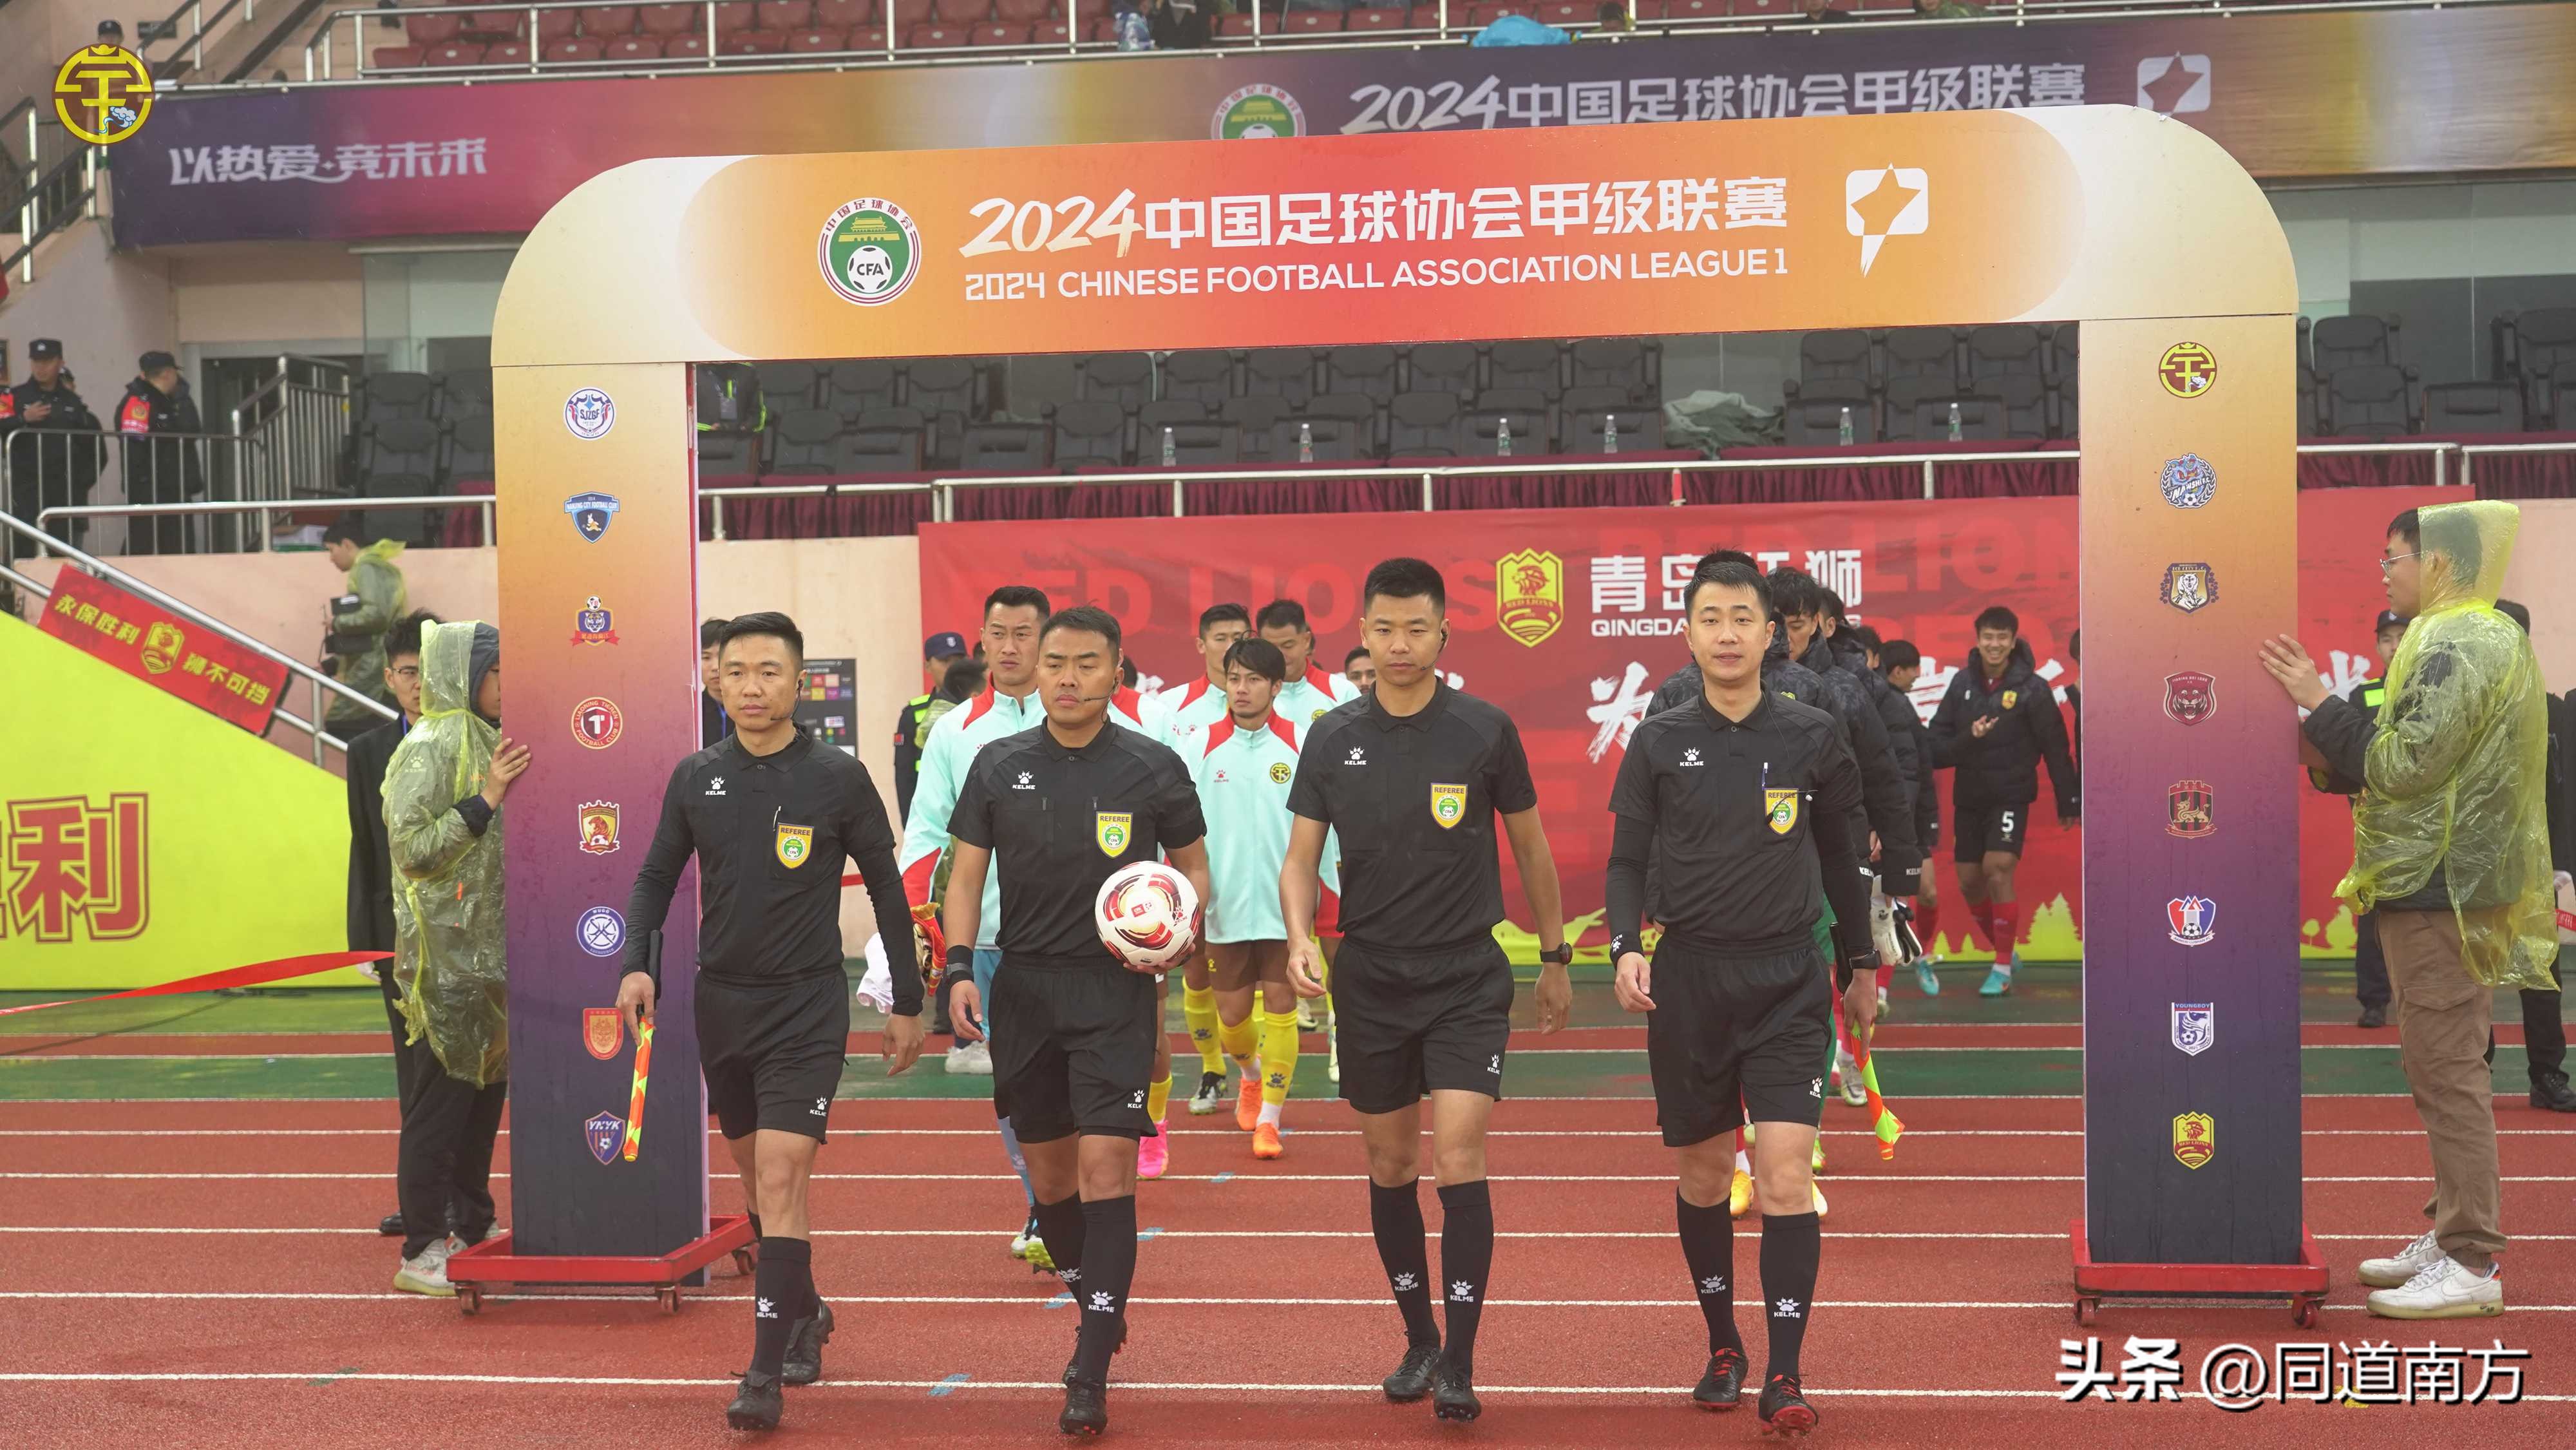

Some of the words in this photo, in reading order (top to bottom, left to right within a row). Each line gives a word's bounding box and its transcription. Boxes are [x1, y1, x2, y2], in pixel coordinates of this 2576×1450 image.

[826, 199, 913, 232] 中国足球协会
[857, 263, 884, 276] CFA
[965, 272, 1045, 301] 2024
[1058, 267, 1199, 298] CHINESE
[1207, 262, 1384, 293] FOOTBALL
[1391, 253, 1622, 287] ASSOCIATION
[1631, 248, 1768, 280] LEAGUE
[1775, 248, 1788, 274] 1
[55, 593, 141, 645] 永保胜利
[1591, 618, 1688, 637] QINGDA
[2002, 810, 2014, 833] 5
[781, 827, 811, 836] REFEREE
[1395, 1282, 1419, 1292] KELME
[1701, 1284, 1726, 1293] KELME
[1088, 1304, 1115, 1313] KELME
